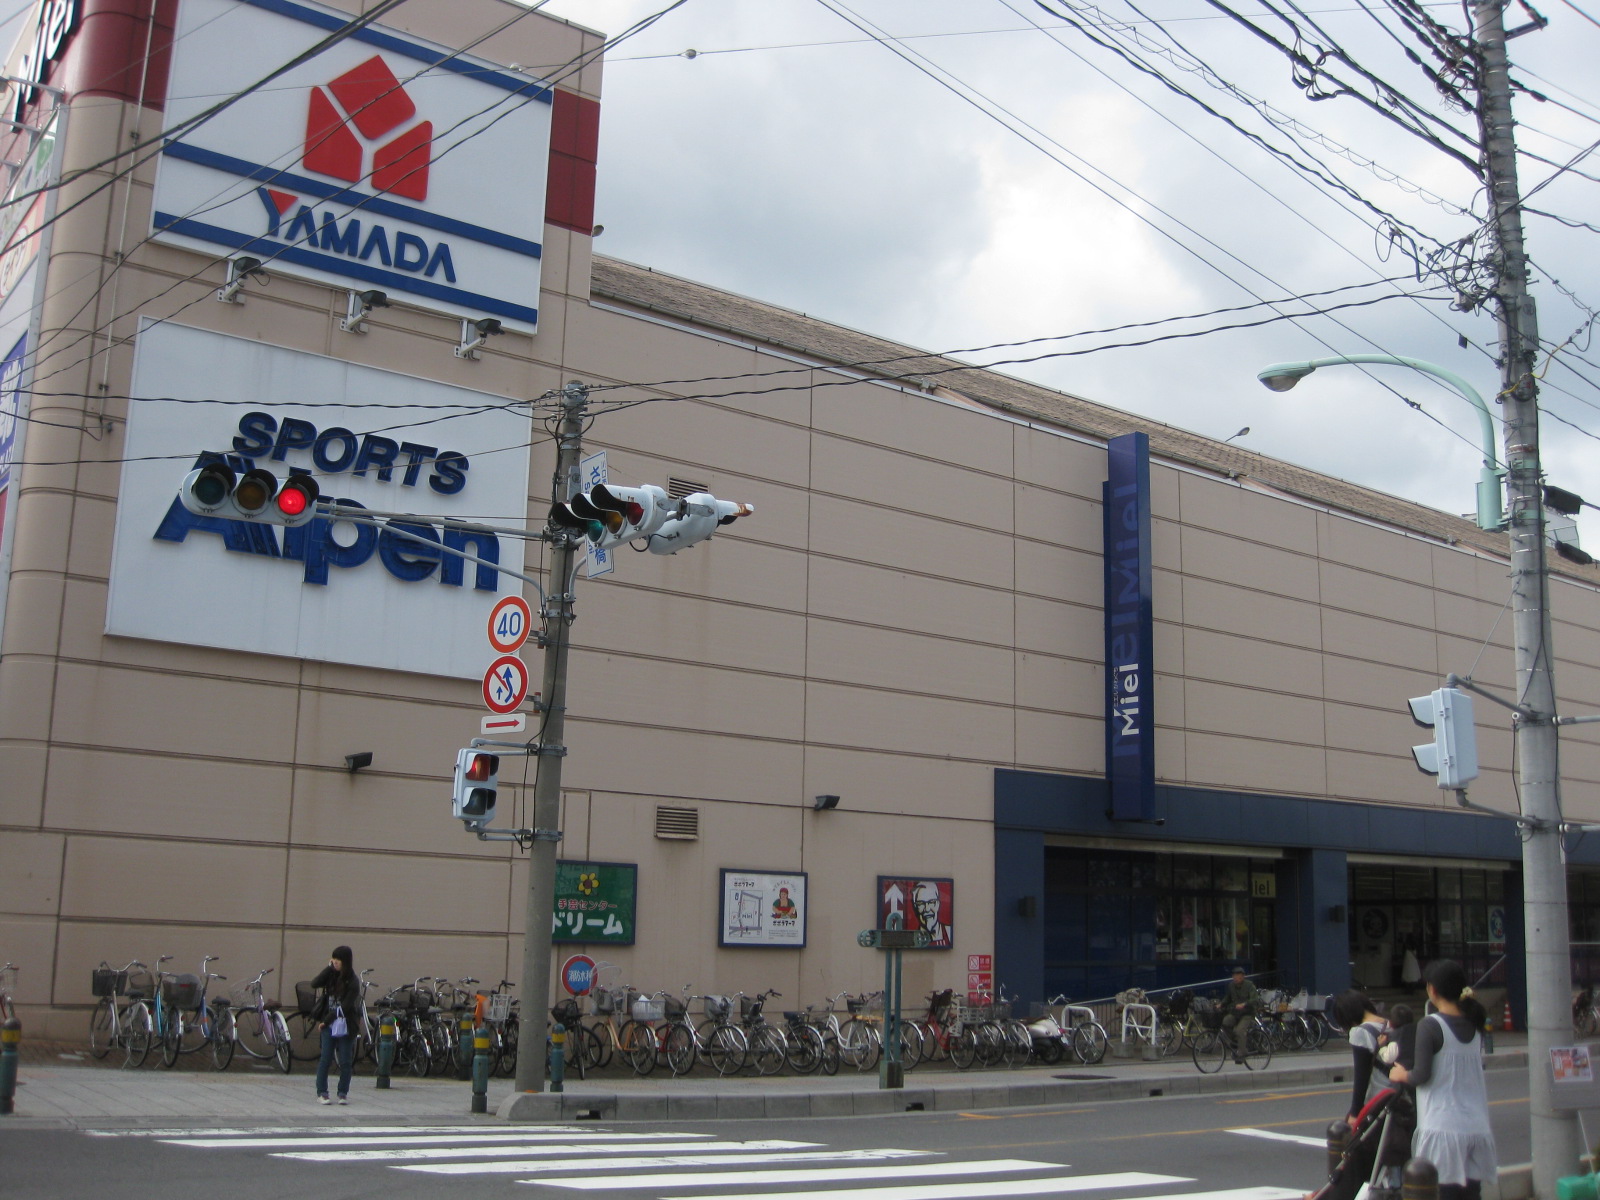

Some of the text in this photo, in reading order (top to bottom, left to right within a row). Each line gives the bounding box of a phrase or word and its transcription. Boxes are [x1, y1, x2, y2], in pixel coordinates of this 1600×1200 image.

[257, 187, 457, 284] YAMADA
[232, 411, 470, 496] SPORTS
[497, 611, 521, 637] 40
[1114, 663, 1140, 736] Miel
[552, 911, 623, 935] ドリーム
[558, 899, 618, 911] 手芸センター
